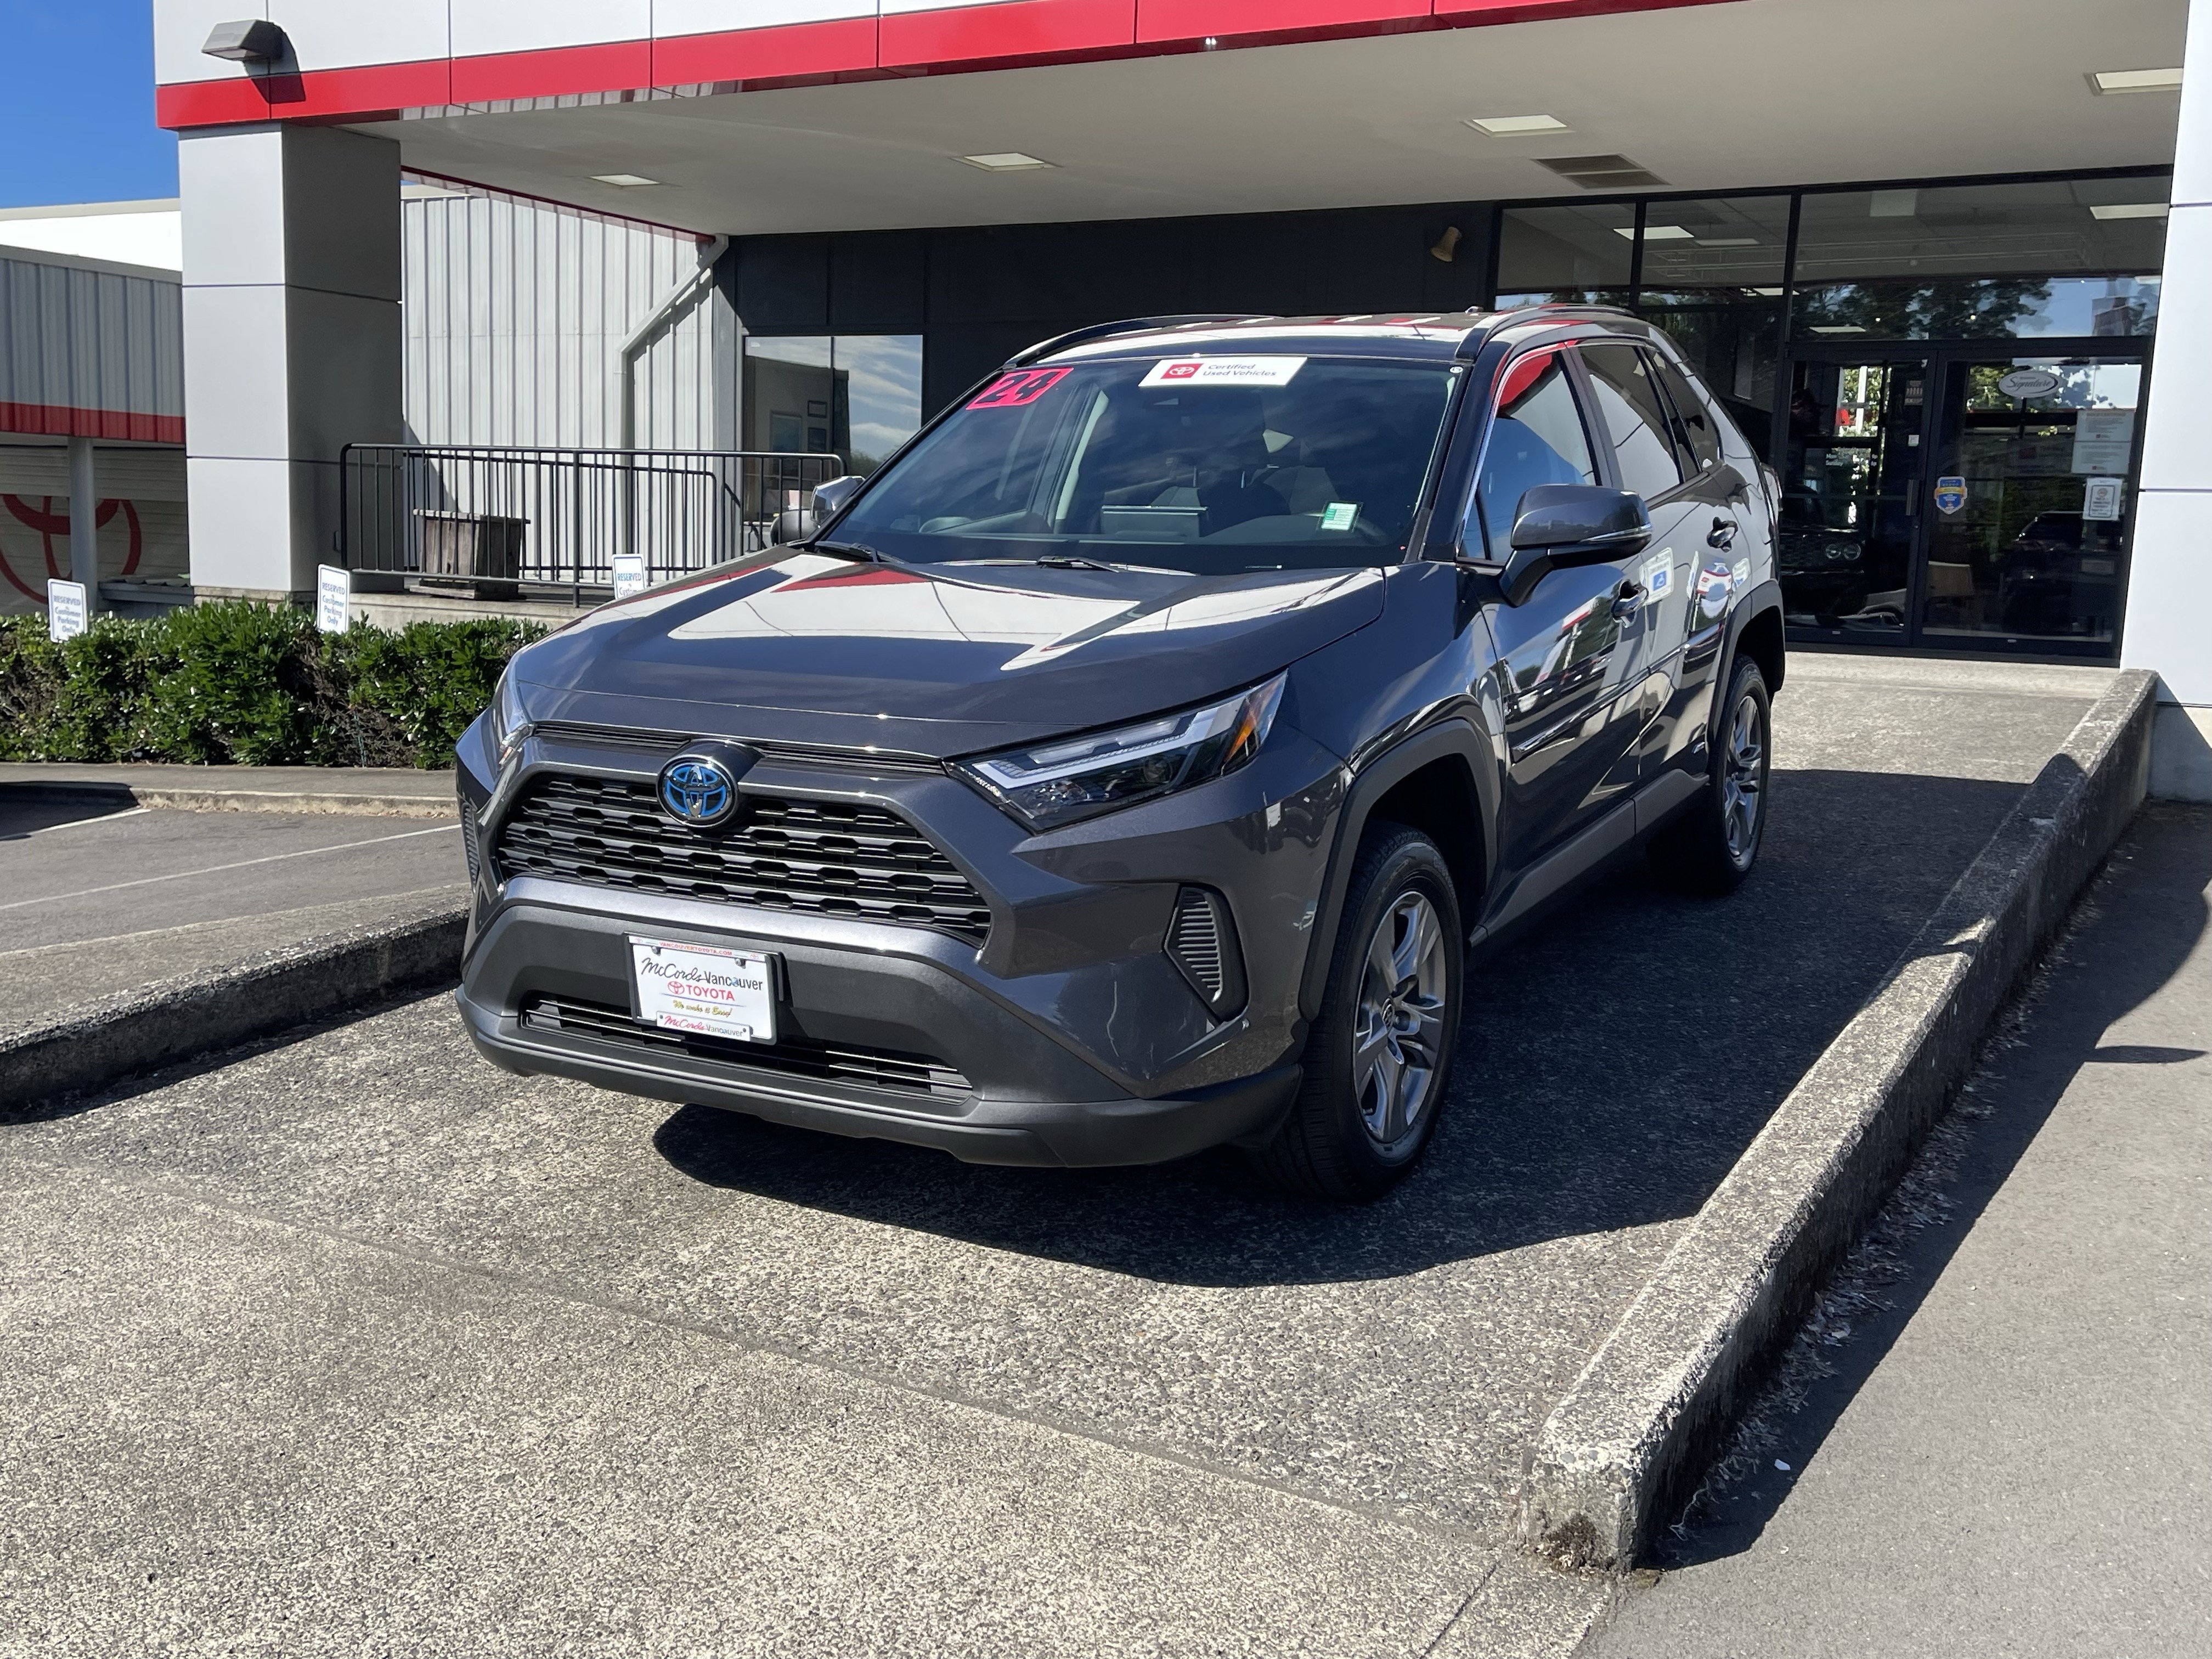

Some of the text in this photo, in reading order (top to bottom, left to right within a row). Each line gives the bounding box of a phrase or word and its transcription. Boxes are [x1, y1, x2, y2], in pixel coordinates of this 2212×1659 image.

[971, 370, 1065, 406] 24
[617, 573, 642, 581] RESERVED
[322, 583, 345, 595] RESERVED
[659, 941, 733, 956] VANCOUVERTOYOTA.COM
[686, 984, 736, 1002] TOYOTA
